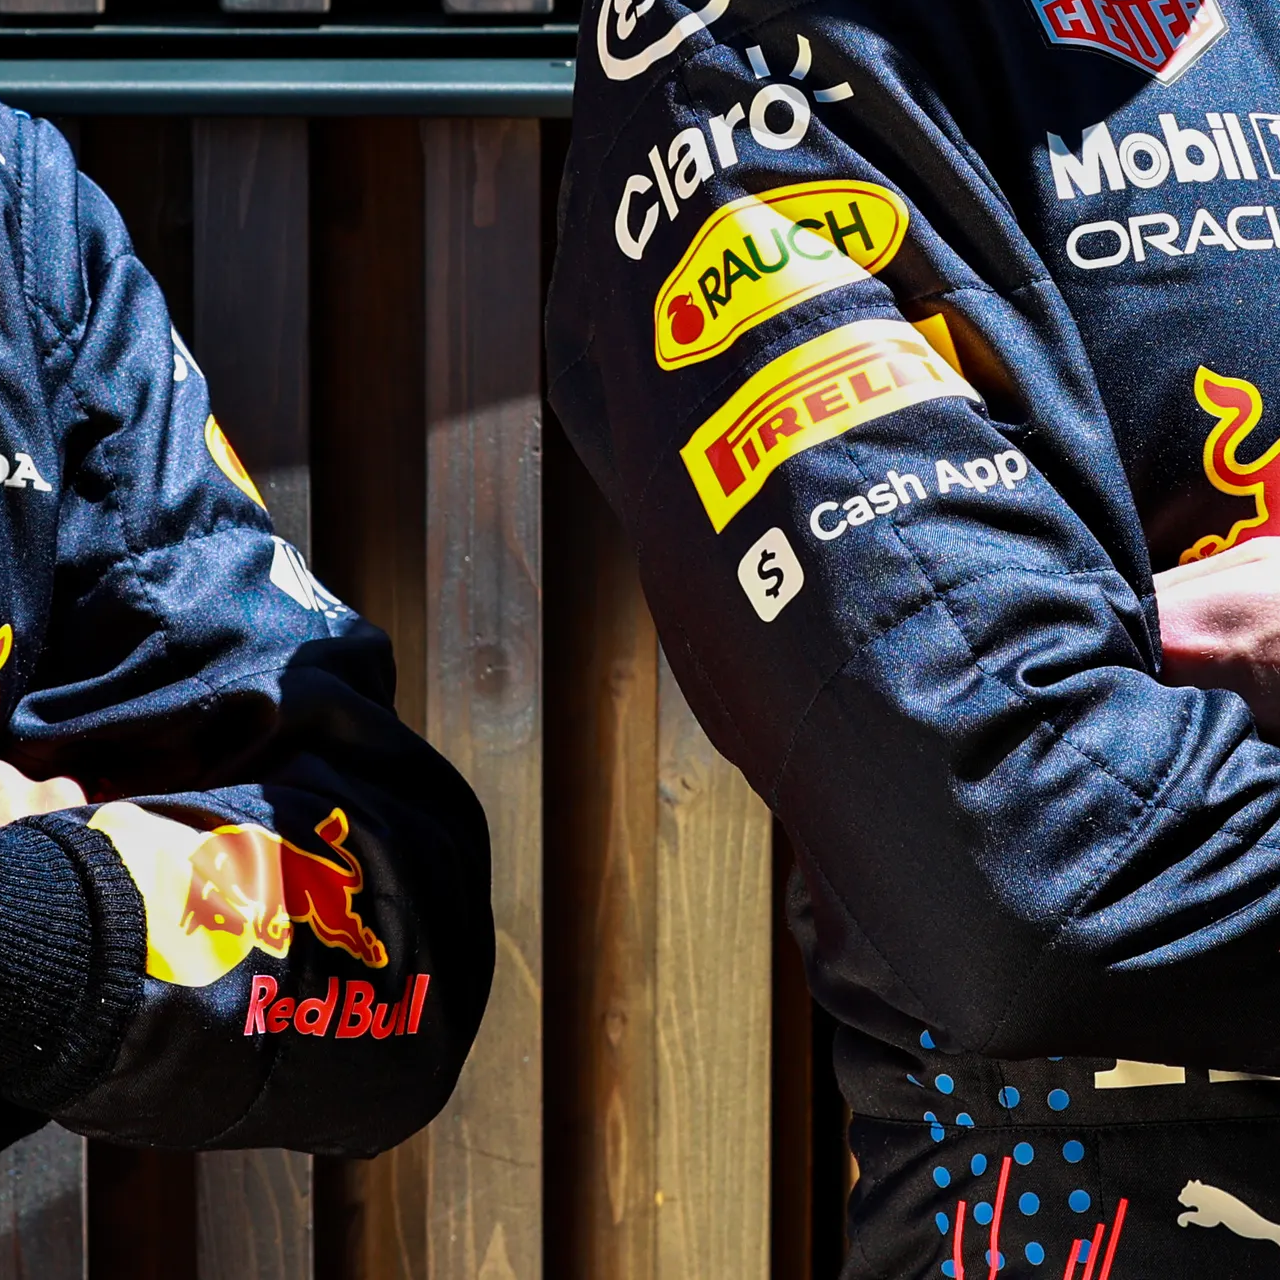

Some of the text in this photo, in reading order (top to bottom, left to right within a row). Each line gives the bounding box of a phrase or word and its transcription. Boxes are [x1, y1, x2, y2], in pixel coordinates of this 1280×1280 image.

[614, 83, 811, 262] Claro
[1046, 112, 1259, 200] Mobil
[697, 200, 875, 321] RAUCH
[809, 449, 1028, 542] Cash App
[243, 973, 430, 1040] Red Bull
